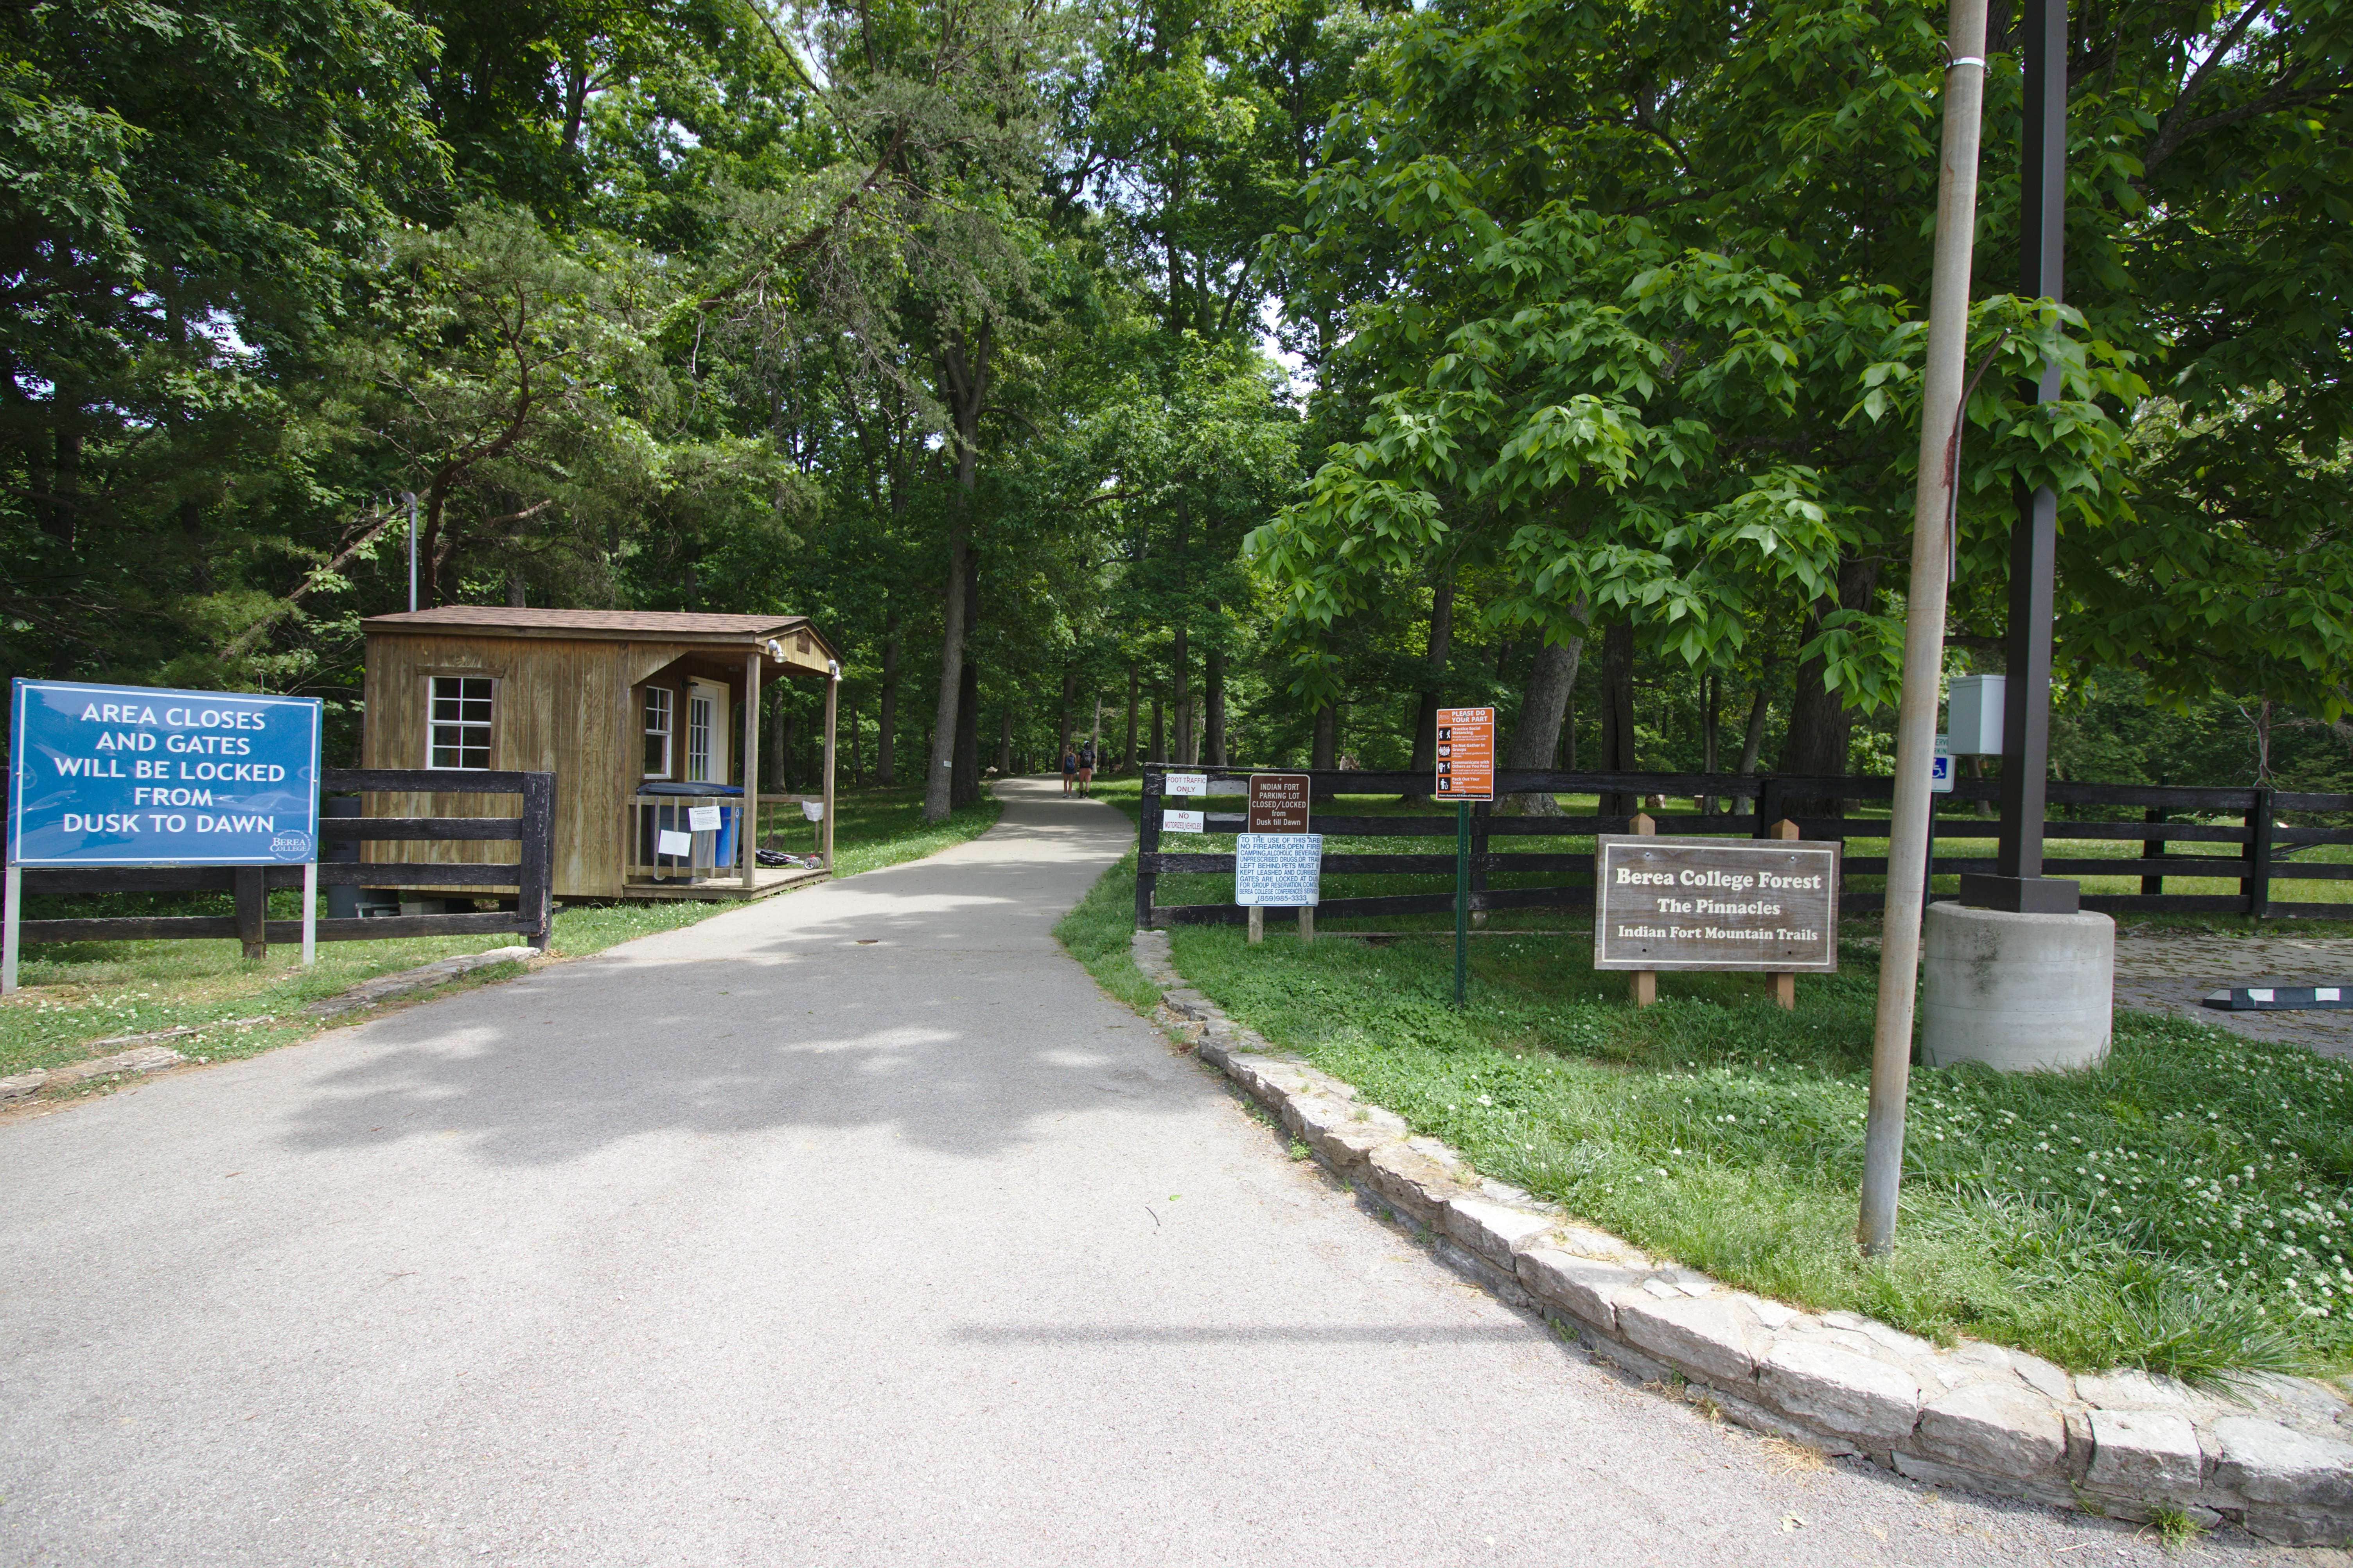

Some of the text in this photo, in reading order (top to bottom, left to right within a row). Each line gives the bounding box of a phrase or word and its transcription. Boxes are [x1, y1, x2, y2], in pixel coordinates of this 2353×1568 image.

[81, 703, 265, 730] AREA CLOSES
[96, 732, 250, 755] AND GATES
[54, 758, 285, 781] WILL BE LOCKED
[135, 788, 213, 806] FROM
[1252, 801, 1306, 810] CLOSED/LOCKED
[64, 814, 274, 833] DUSK TO DAWN
[1616, 868, 1821, 890] Berea College Forest
[1657, 899, 1780, 915] The Pinnacles
[1618, 926, 1818, 940] Indian Fort Mountain Trails
